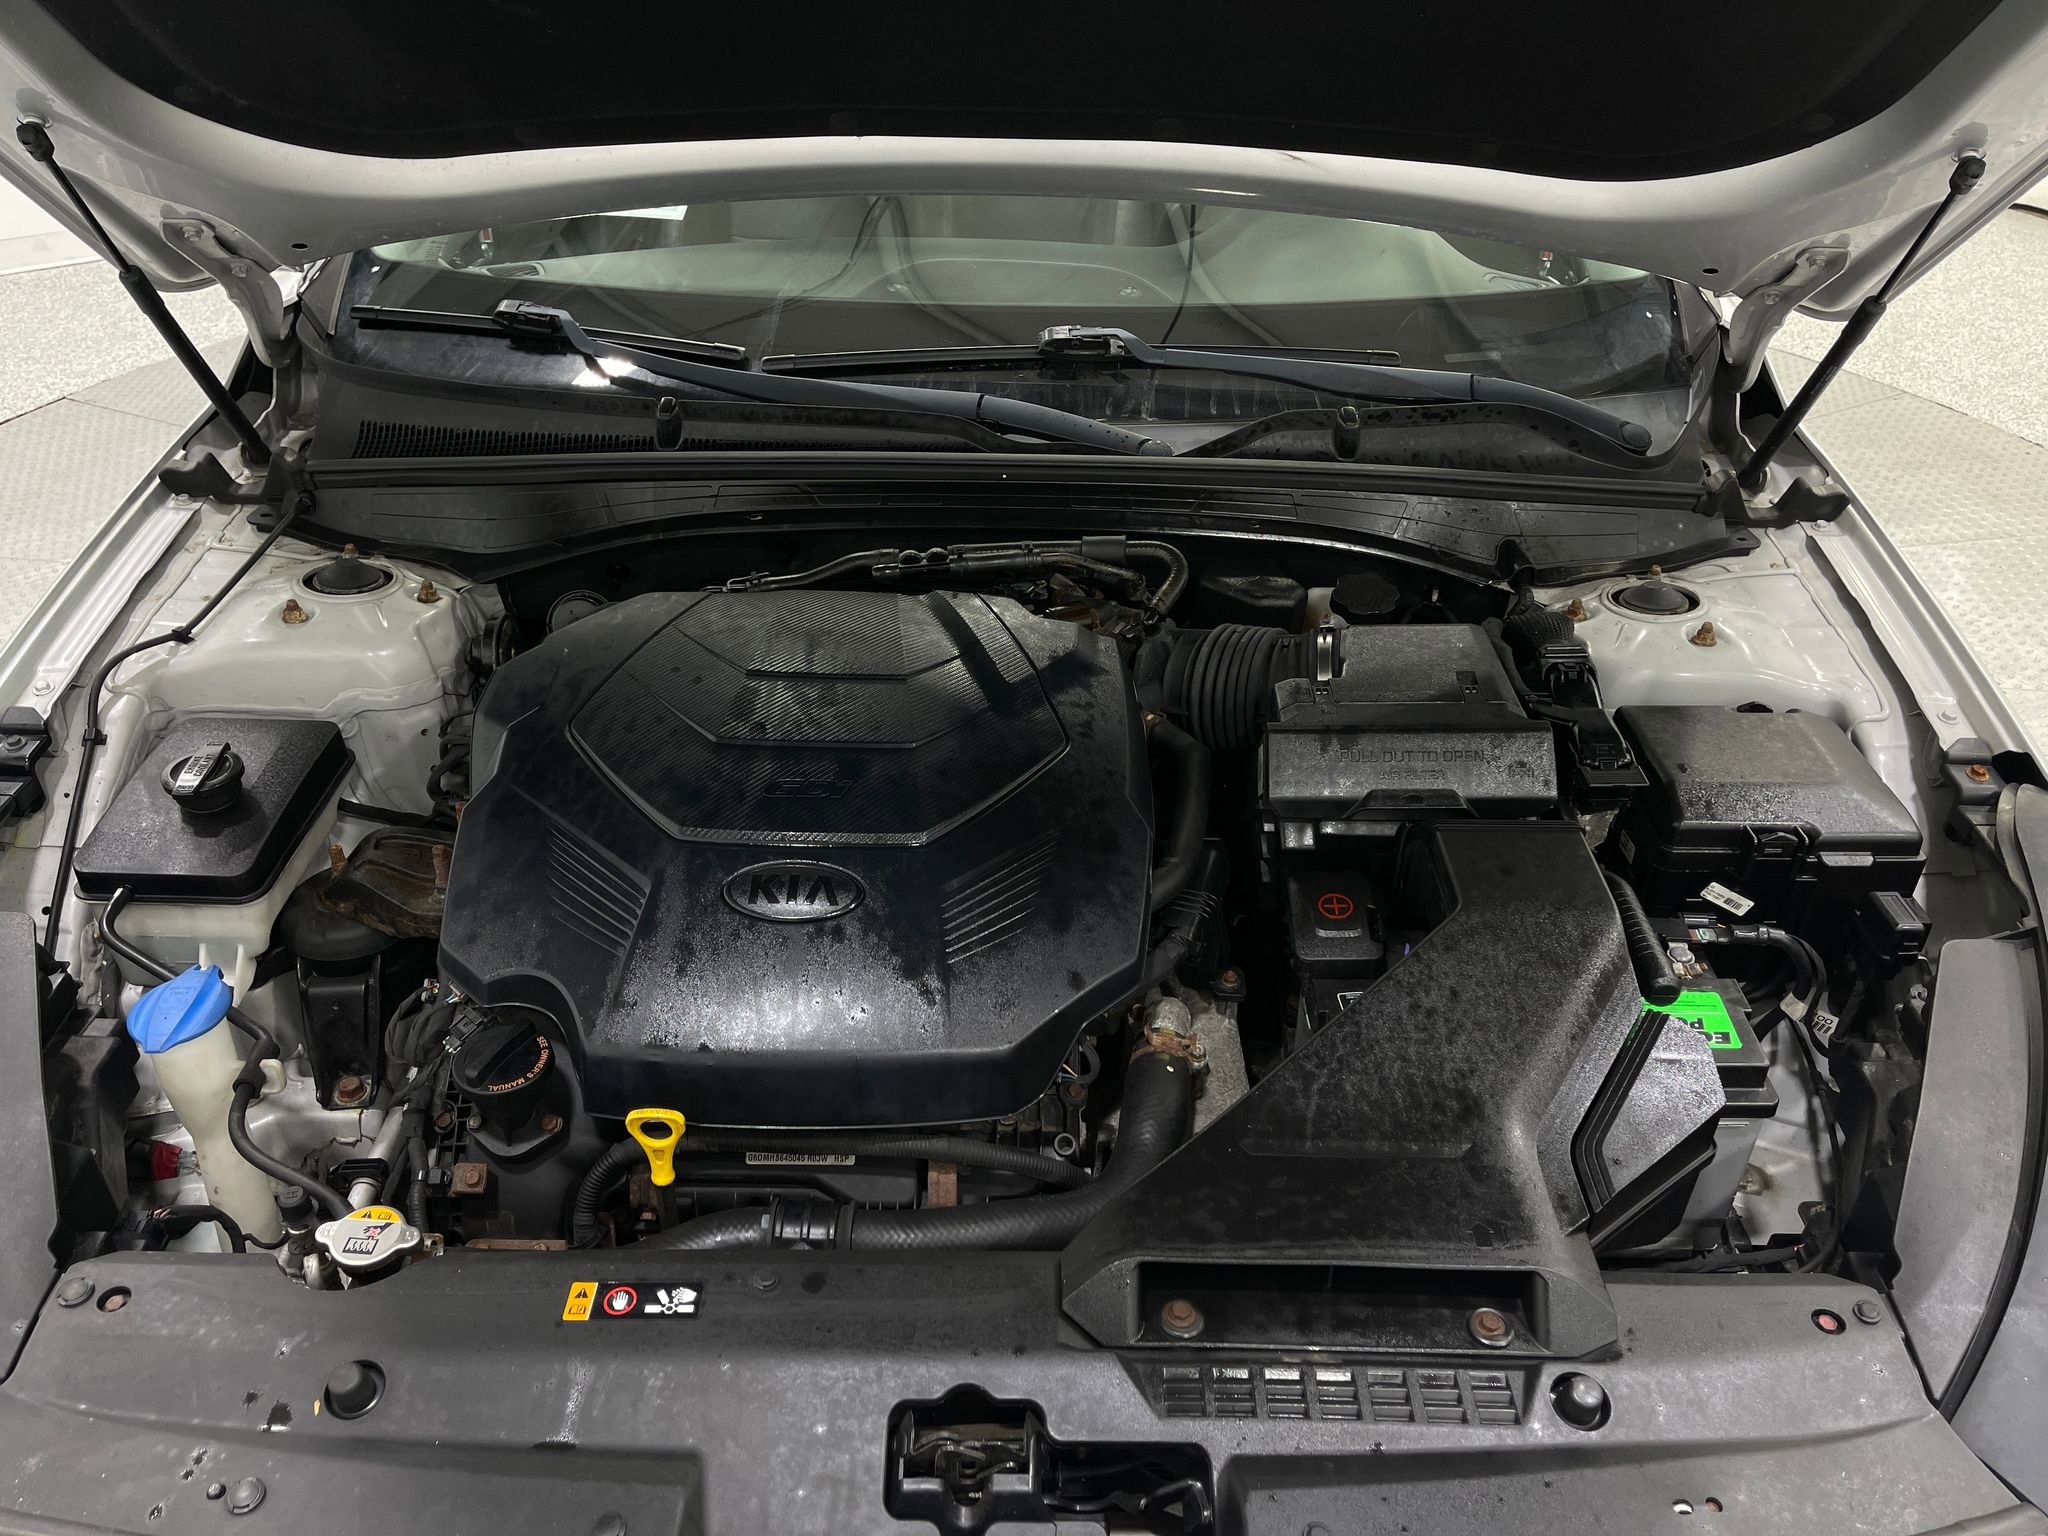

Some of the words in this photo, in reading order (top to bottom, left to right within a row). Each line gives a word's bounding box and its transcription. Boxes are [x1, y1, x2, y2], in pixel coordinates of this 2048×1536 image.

[1339, 749, 1378, 763] PULL
[1382, 749, 1412, 763] OUT
[1416, 749, 1438, 763] TO
[1442, 749, 1484, 763] OPEN
[748, 874, 839, 906] KIA
[536, 1035, 549, 1048] SEE
[526, 1049, 550, 1079] OWNER'S
[487, 1077, 526, 1092] MANUAL
